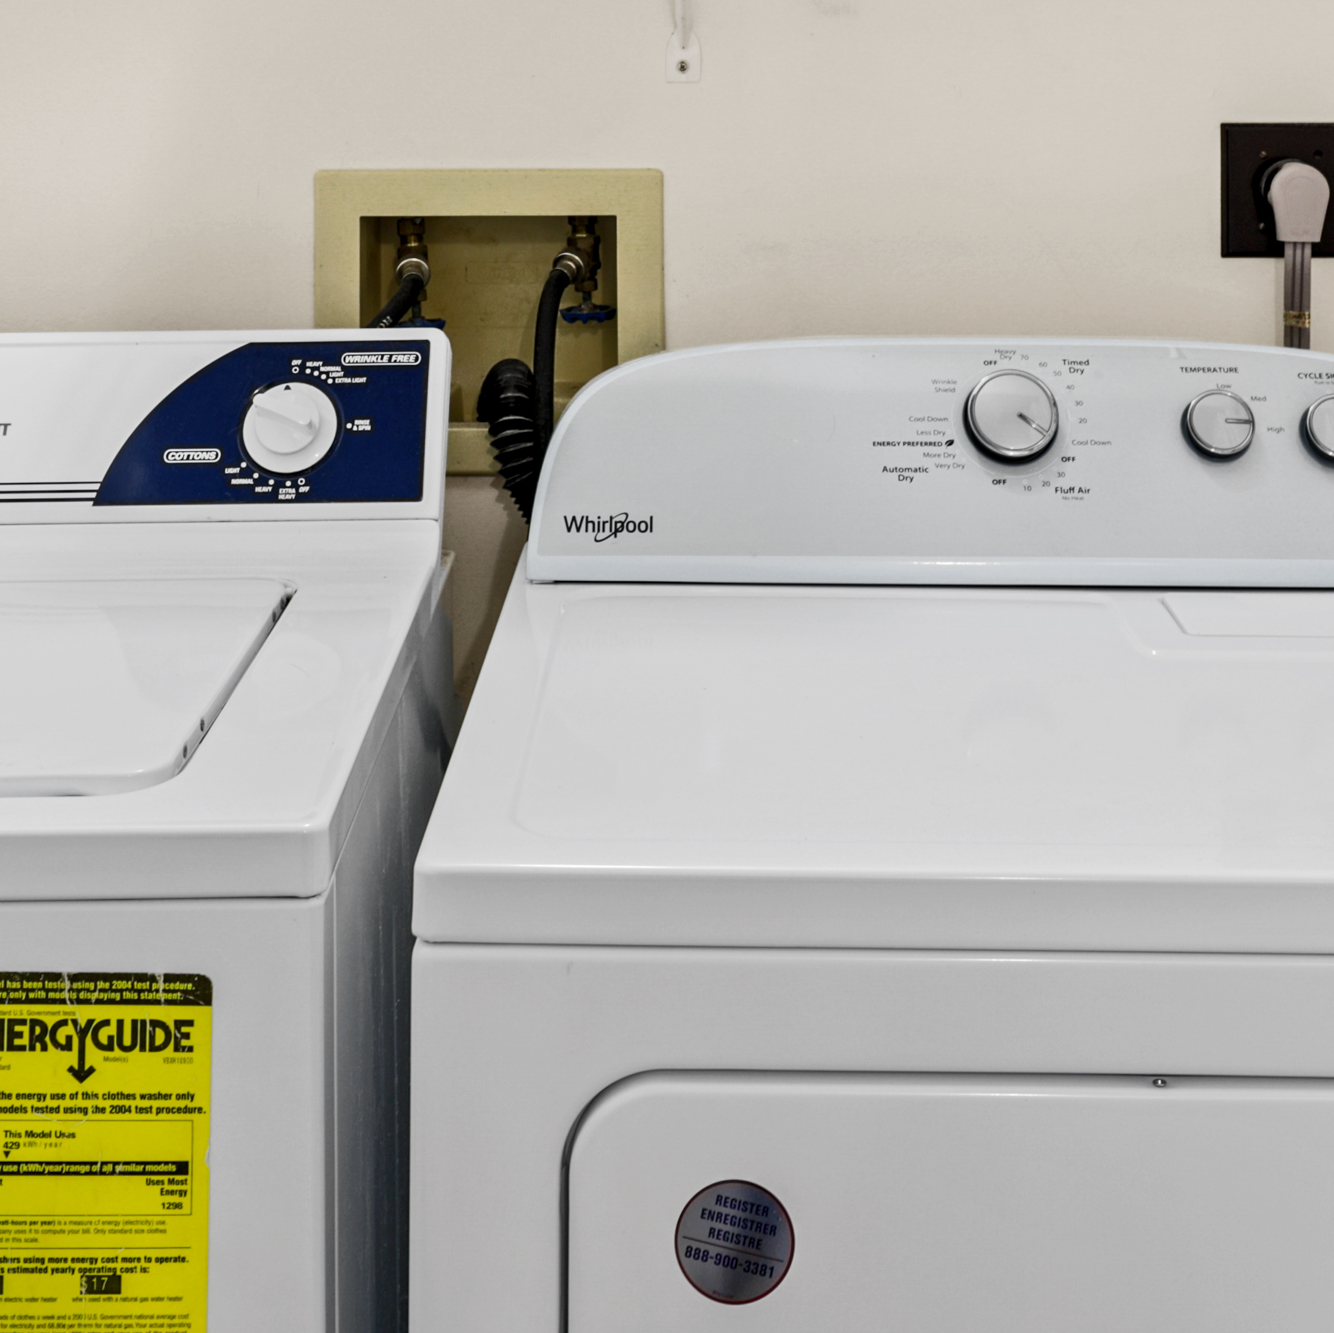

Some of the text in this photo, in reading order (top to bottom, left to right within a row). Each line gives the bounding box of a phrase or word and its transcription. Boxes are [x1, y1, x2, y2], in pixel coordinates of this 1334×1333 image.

[345, 354, 416, 363] WRINKLE FREE
[1062, 358, 1090, 366] Timed
[1068, 367, 1085, 376] Dry
[933, 429, 946, 437] Dry
[167, 451, 217, 461] COTTONS
[882, 465, 929, 473] Automatic
[897, 474, 914, 483] Dry
[1054, 486, 1091, 494] Fluff Air
[563, 512, 654, 543] Whirlpool
[6, 980, 22, 989] has
[23, 980, 43, 989] been
[73, 980, 95, 991] using
[96, 981, 110, 989] the
[133, 981, 149, 990] test
[8, 990, 27, 1000] only
[28, 990, 46, 999] with
[123, 991, 138, 1000] this
[15, 1093, 47, 1102] energy
[69, 1091, 79, 1100] of
[81, 1091, 99, 1100] this
[102, 1091, 137, 1100] clothes
[139, 1091, 173, 1100] washer
[175, 1091, 195, 1102] only
[31, 1105, 60, 1114] tested
[63, 1105, 88, 1116] using
[109, 1105, 132, 1114] 2004
[135, 1105, 153, 1114] test
[156, 1105, 207, 1116] procedure.
[3, 1130, 22, 1139] This
[25, 1130, 52, 1139] Model
[3, 1141, 21, 1150] 429
[3, 1164, 18, 1172] use
[65, 1164, 90, 1173] range
[146, 1163, 177, 1172] models
[146, 1178, 188, 1186] Uses Most
[160, 1187, 188, 1197] Energy
[161, 1202, 183, 1210] 1298
[715, 1194, 770, 1218] REGISTER
[700, 1207, 777, 1237] ENREGISTRER
[707, 1227, 763, 1251] REGISTRE
[23, 1256, 45, 1265] using
[70, 1256, 98, 1265] energy
[101, 1255, 118, 1263] cost
[143, 1255, 152, 1263] to
[154, 1255, 189, 1264] operate.
[7, 1265, 48, 1274] estimated
[51, 1266, 75, 1275] yearly
[78, 1266, 117, 1275] operating
[120, 1265, 137, 1273] cost
[139, 1265, 150, 1273] is:
